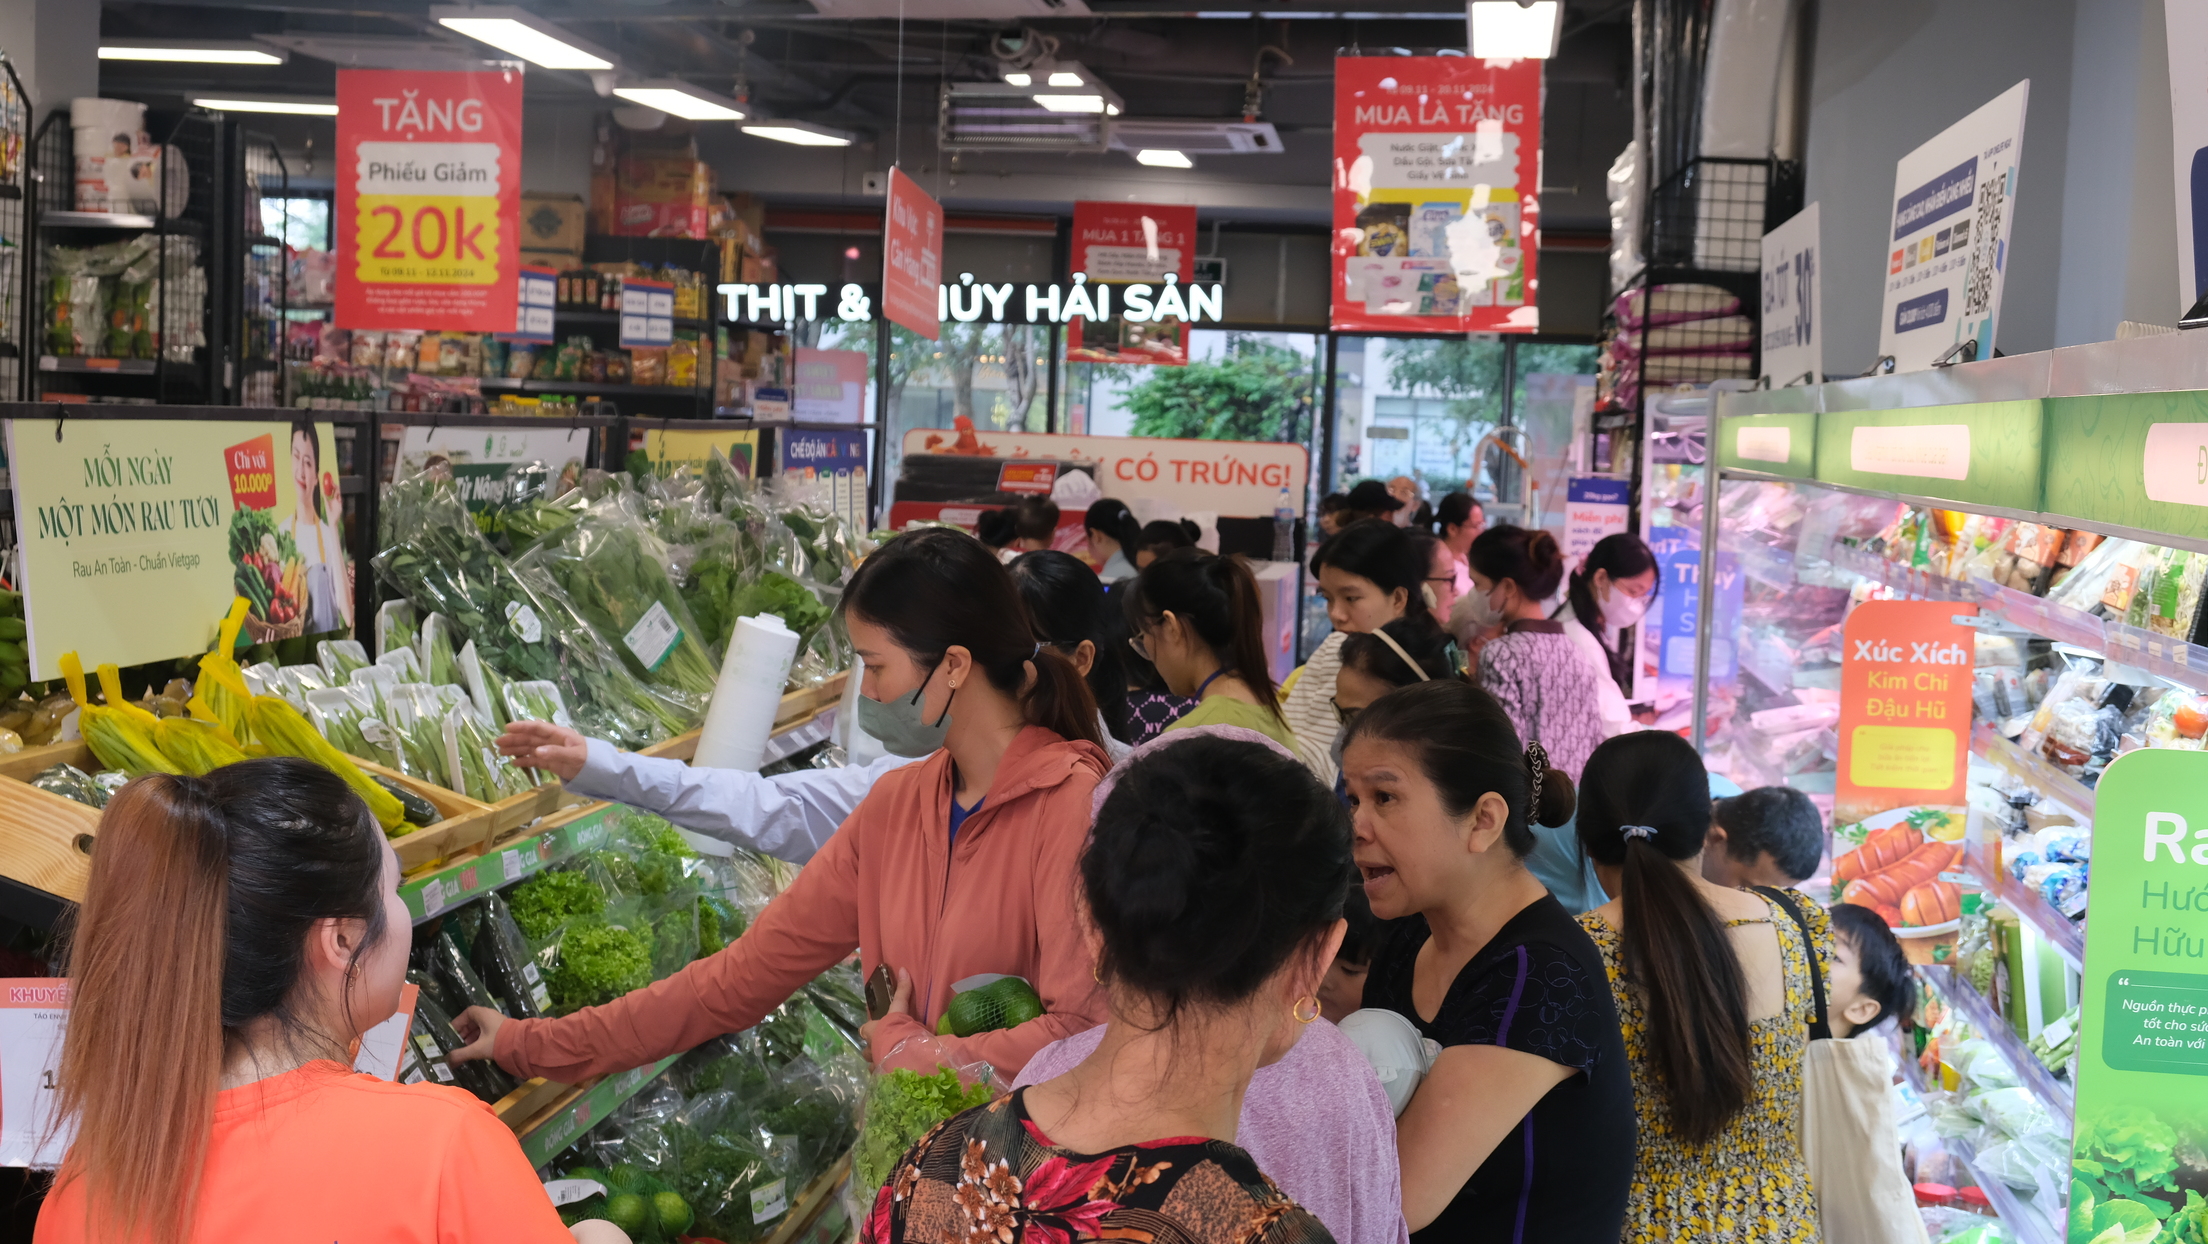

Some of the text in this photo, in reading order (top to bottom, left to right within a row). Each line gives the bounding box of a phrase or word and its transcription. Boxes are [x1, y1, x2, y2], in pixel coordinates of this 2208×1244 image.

[372, 88, 483, 141] TẶNG
[1355, 104, 1412, 125] MUA
[1418, 99, 1450, 125] LÀ
[368, 160, 487, 182] Phiếu Giảm
[371, 204, 485, 261] 20k
[717, 283, 828, 330] THỊT
[837, 283, 872, 322] &
[1025, 272, 1110, 323] HẢI
[1123, 272, 1223, 323] SẢN
[83, 443, 173, 488] MỖI NGÀY
[234, 449, 267, 470] Chỉ với
[1115, 451, 1158, 483] CÓ
[1170, 454, 1292, 487] TRỨNG!
[38, 494, 220, 547] MỘT MÓN RAU TƯƠI
[1572, 510, 1624, 525] Miễn phí
[72, 561, 92, 578] Rau
[94, 559, 108, 576] An
[108, 556, 132, 574] Toàn
[139, 551, 167, 571] Chuẩn
[168, 552, 200, 570] Vietgap
[1853, 638, 1967, 666] Xúc Xích
[1867, 670, 1949, 692] Kim Chi
[1865, 697, 1946, 721] Đậu Hũ
[2133, 925, 2205, 959] Hữu
[2121, 999, 2165, 1013] Nguồn
[2168, 1002, 2197, 1016] thực
[2143, 1016, 2162, 1029] tốt
[2164, 1019, 2187, 1031] cho
[2132, 1034, 2206, 1049] An toàn với
